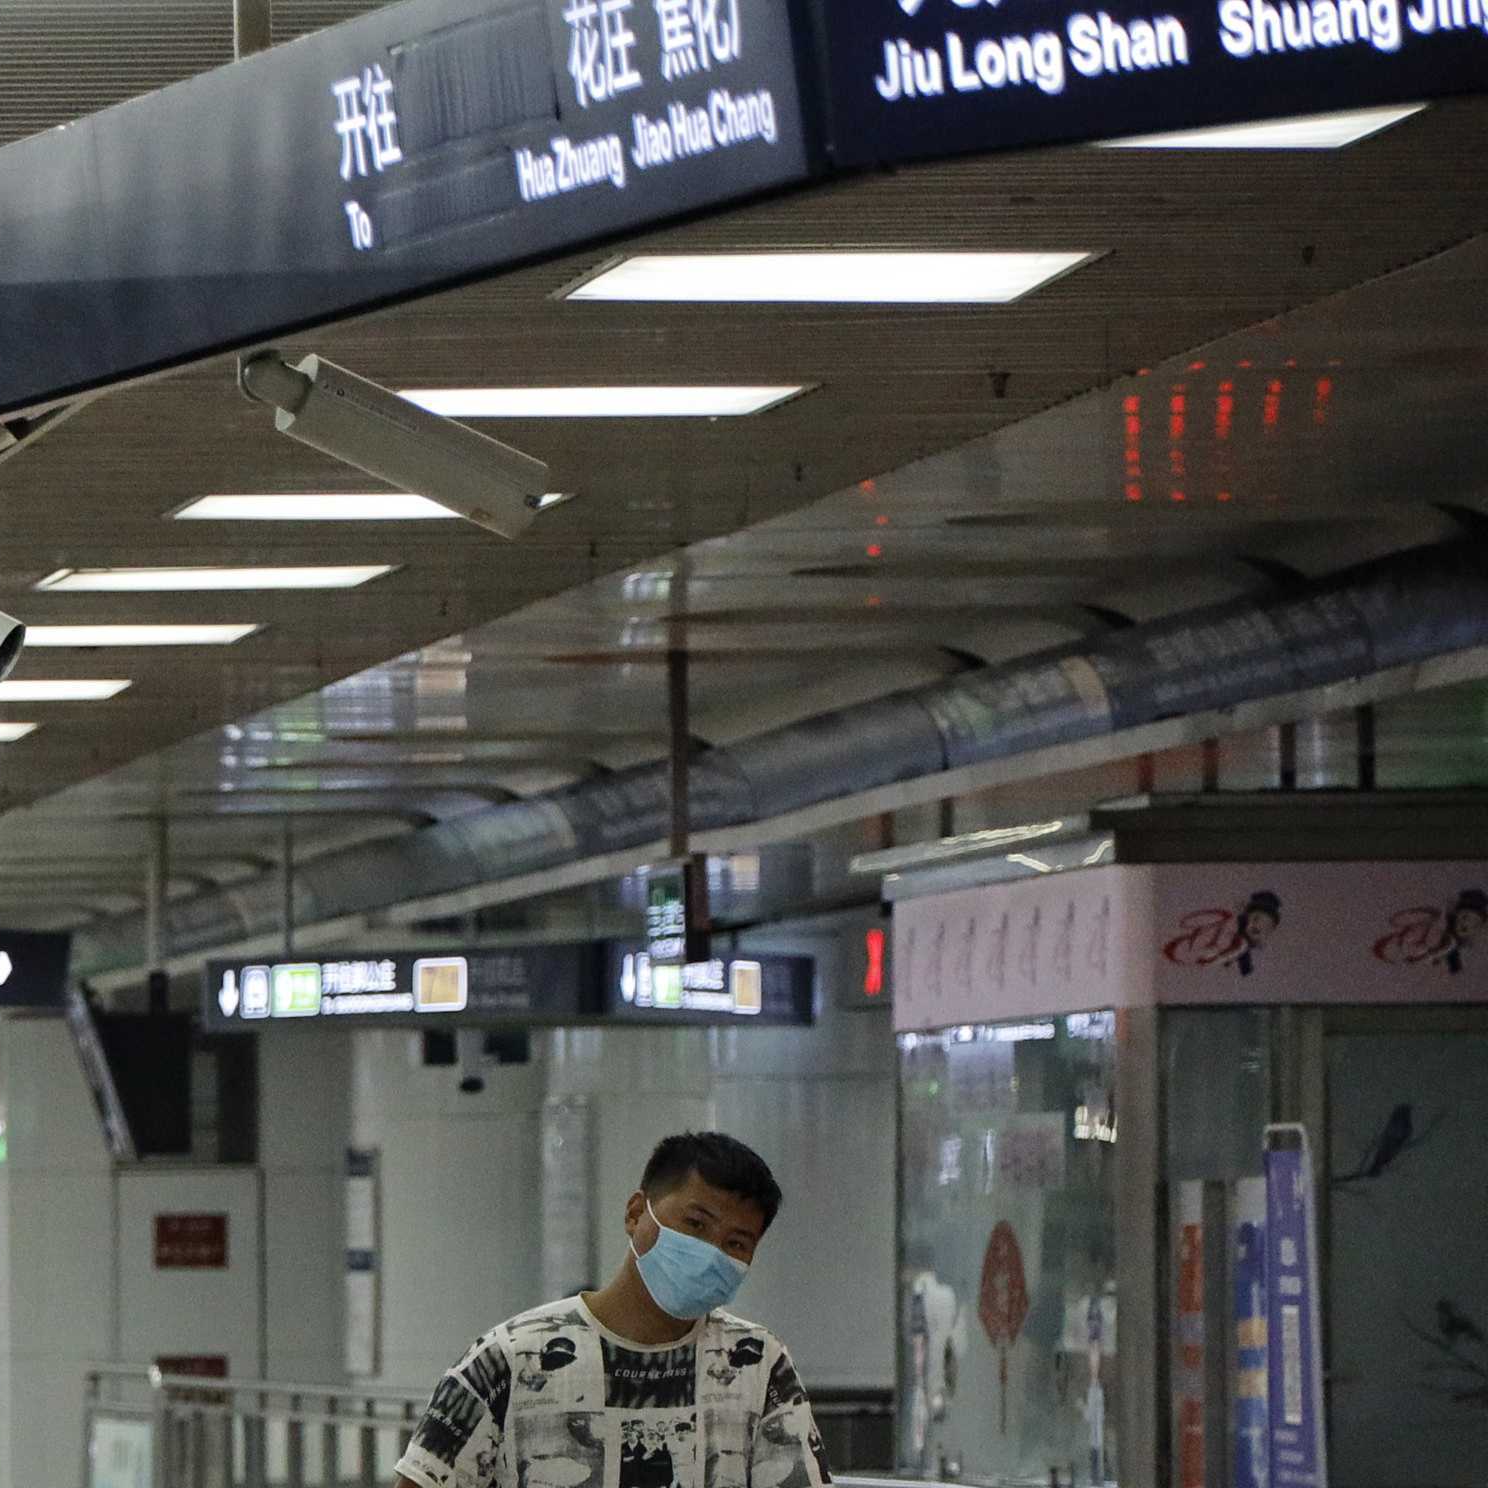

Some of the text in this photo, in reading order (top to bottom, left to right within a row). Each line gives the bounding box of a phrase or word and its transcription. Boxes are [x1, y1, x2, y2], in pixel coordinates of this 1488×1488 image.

[875, 0, 1488, 100] Jiu Long Shan Shuang Jin
[331, 64, 402, 181] 开往
[343, 88, 778, 250] To Hua Zhuang Jiao Hua Chang
